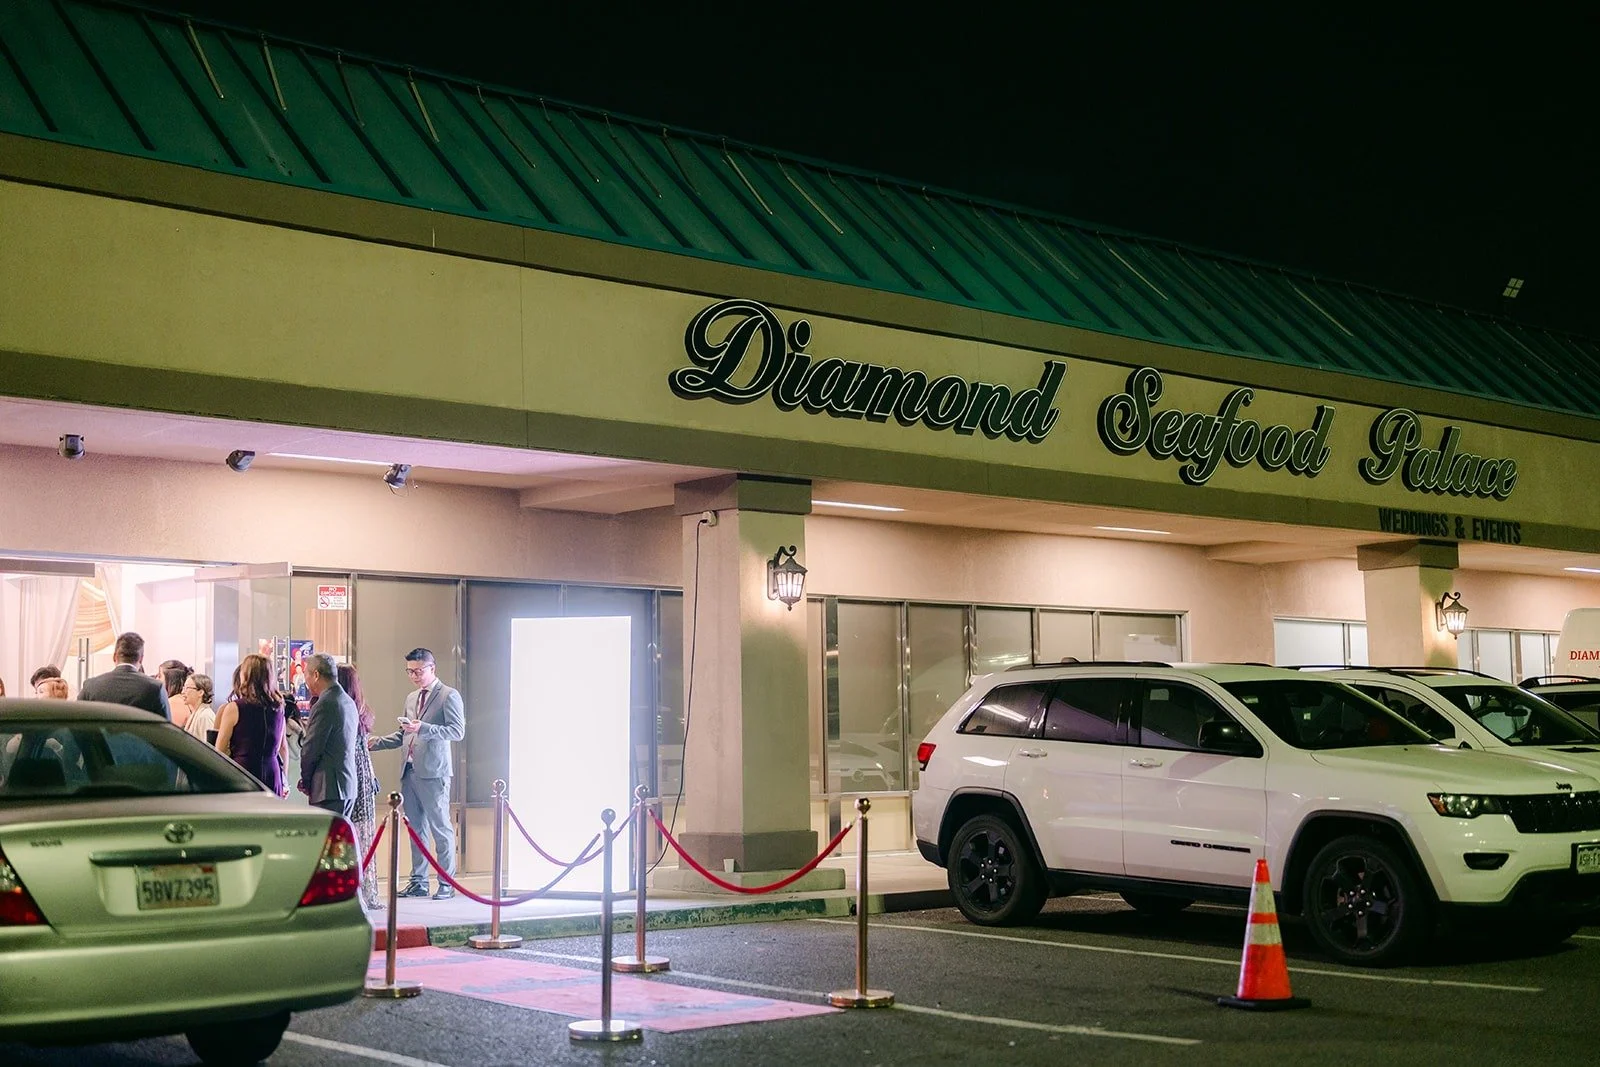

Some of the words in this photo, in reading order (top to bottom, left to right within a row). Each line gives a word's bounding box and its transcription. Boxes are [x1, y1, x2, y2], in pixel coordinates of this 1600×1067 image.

[668, 298, 1068, 444] Diamond
[1097, 366, 1336, 486] Seafood
[1358, 407, 1519, 501] Palace
[1378, 506, 1449, 537] WEDDINGS
[1454, 516, 1466, 539] &
[1472, 518, 1521, 544] EVENTS
